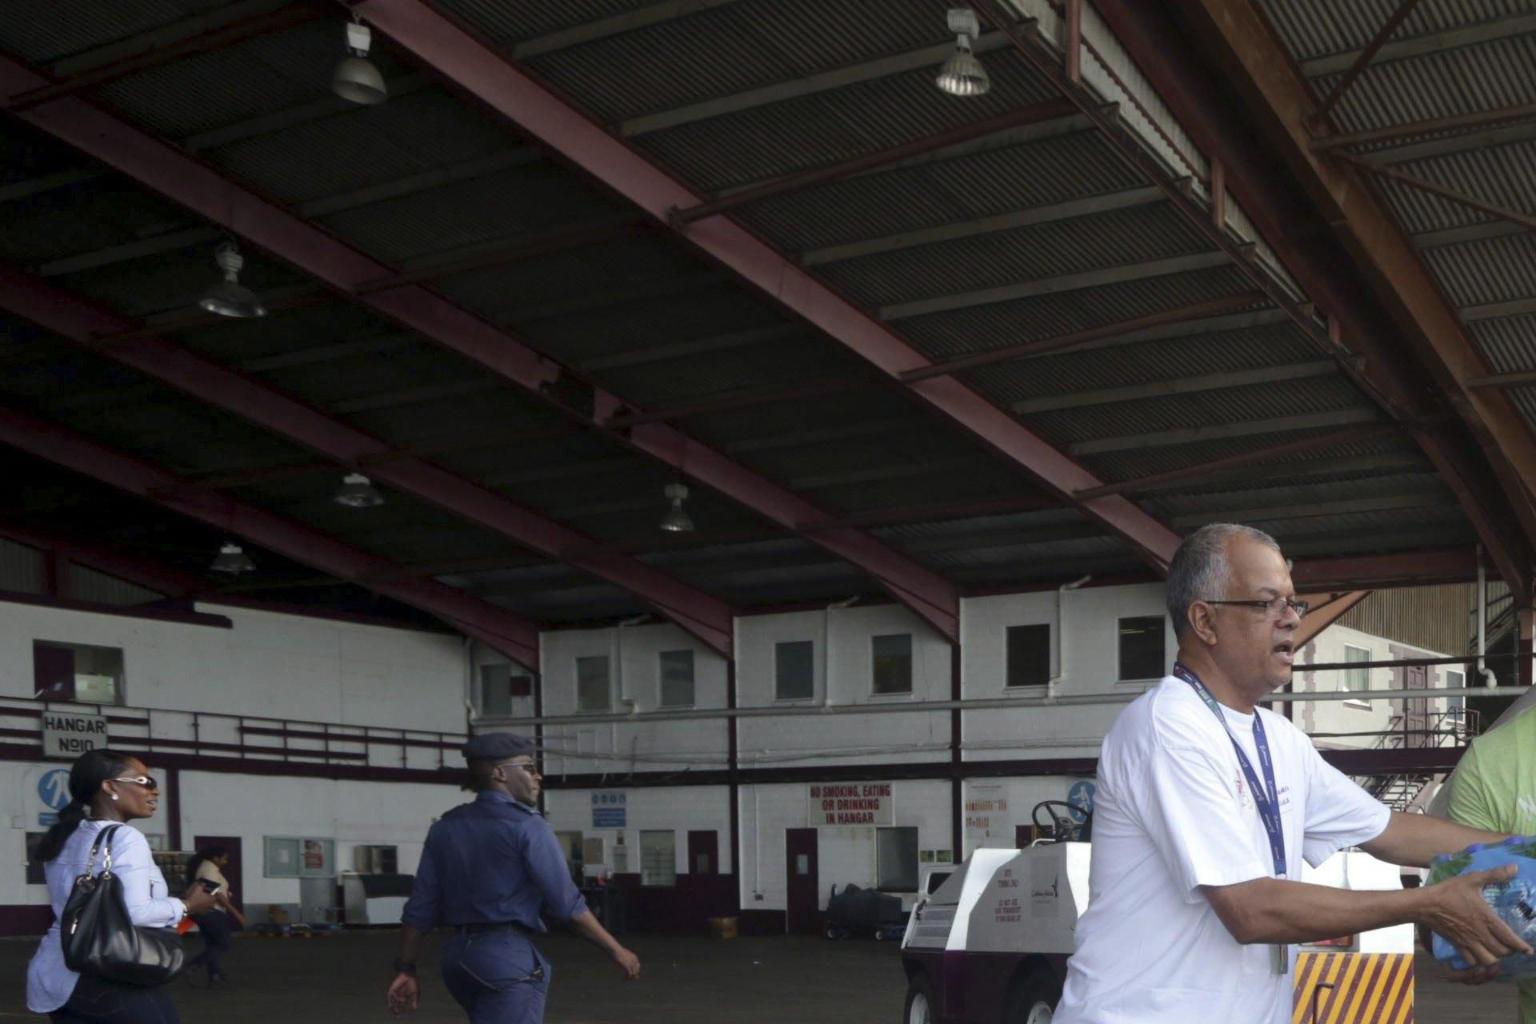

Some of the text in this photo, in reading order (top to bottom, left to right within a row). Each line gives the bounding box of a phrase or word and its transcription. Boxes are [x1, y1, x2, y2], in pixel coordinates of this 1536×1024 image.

[45, 715, 104, 734] HANGAR
[810, 784, 891, 798] NO SMOKING, EATING
[822, 799, 879, 811] OR DRINKING
[826, 812, 874, 824] IN HANGAR
